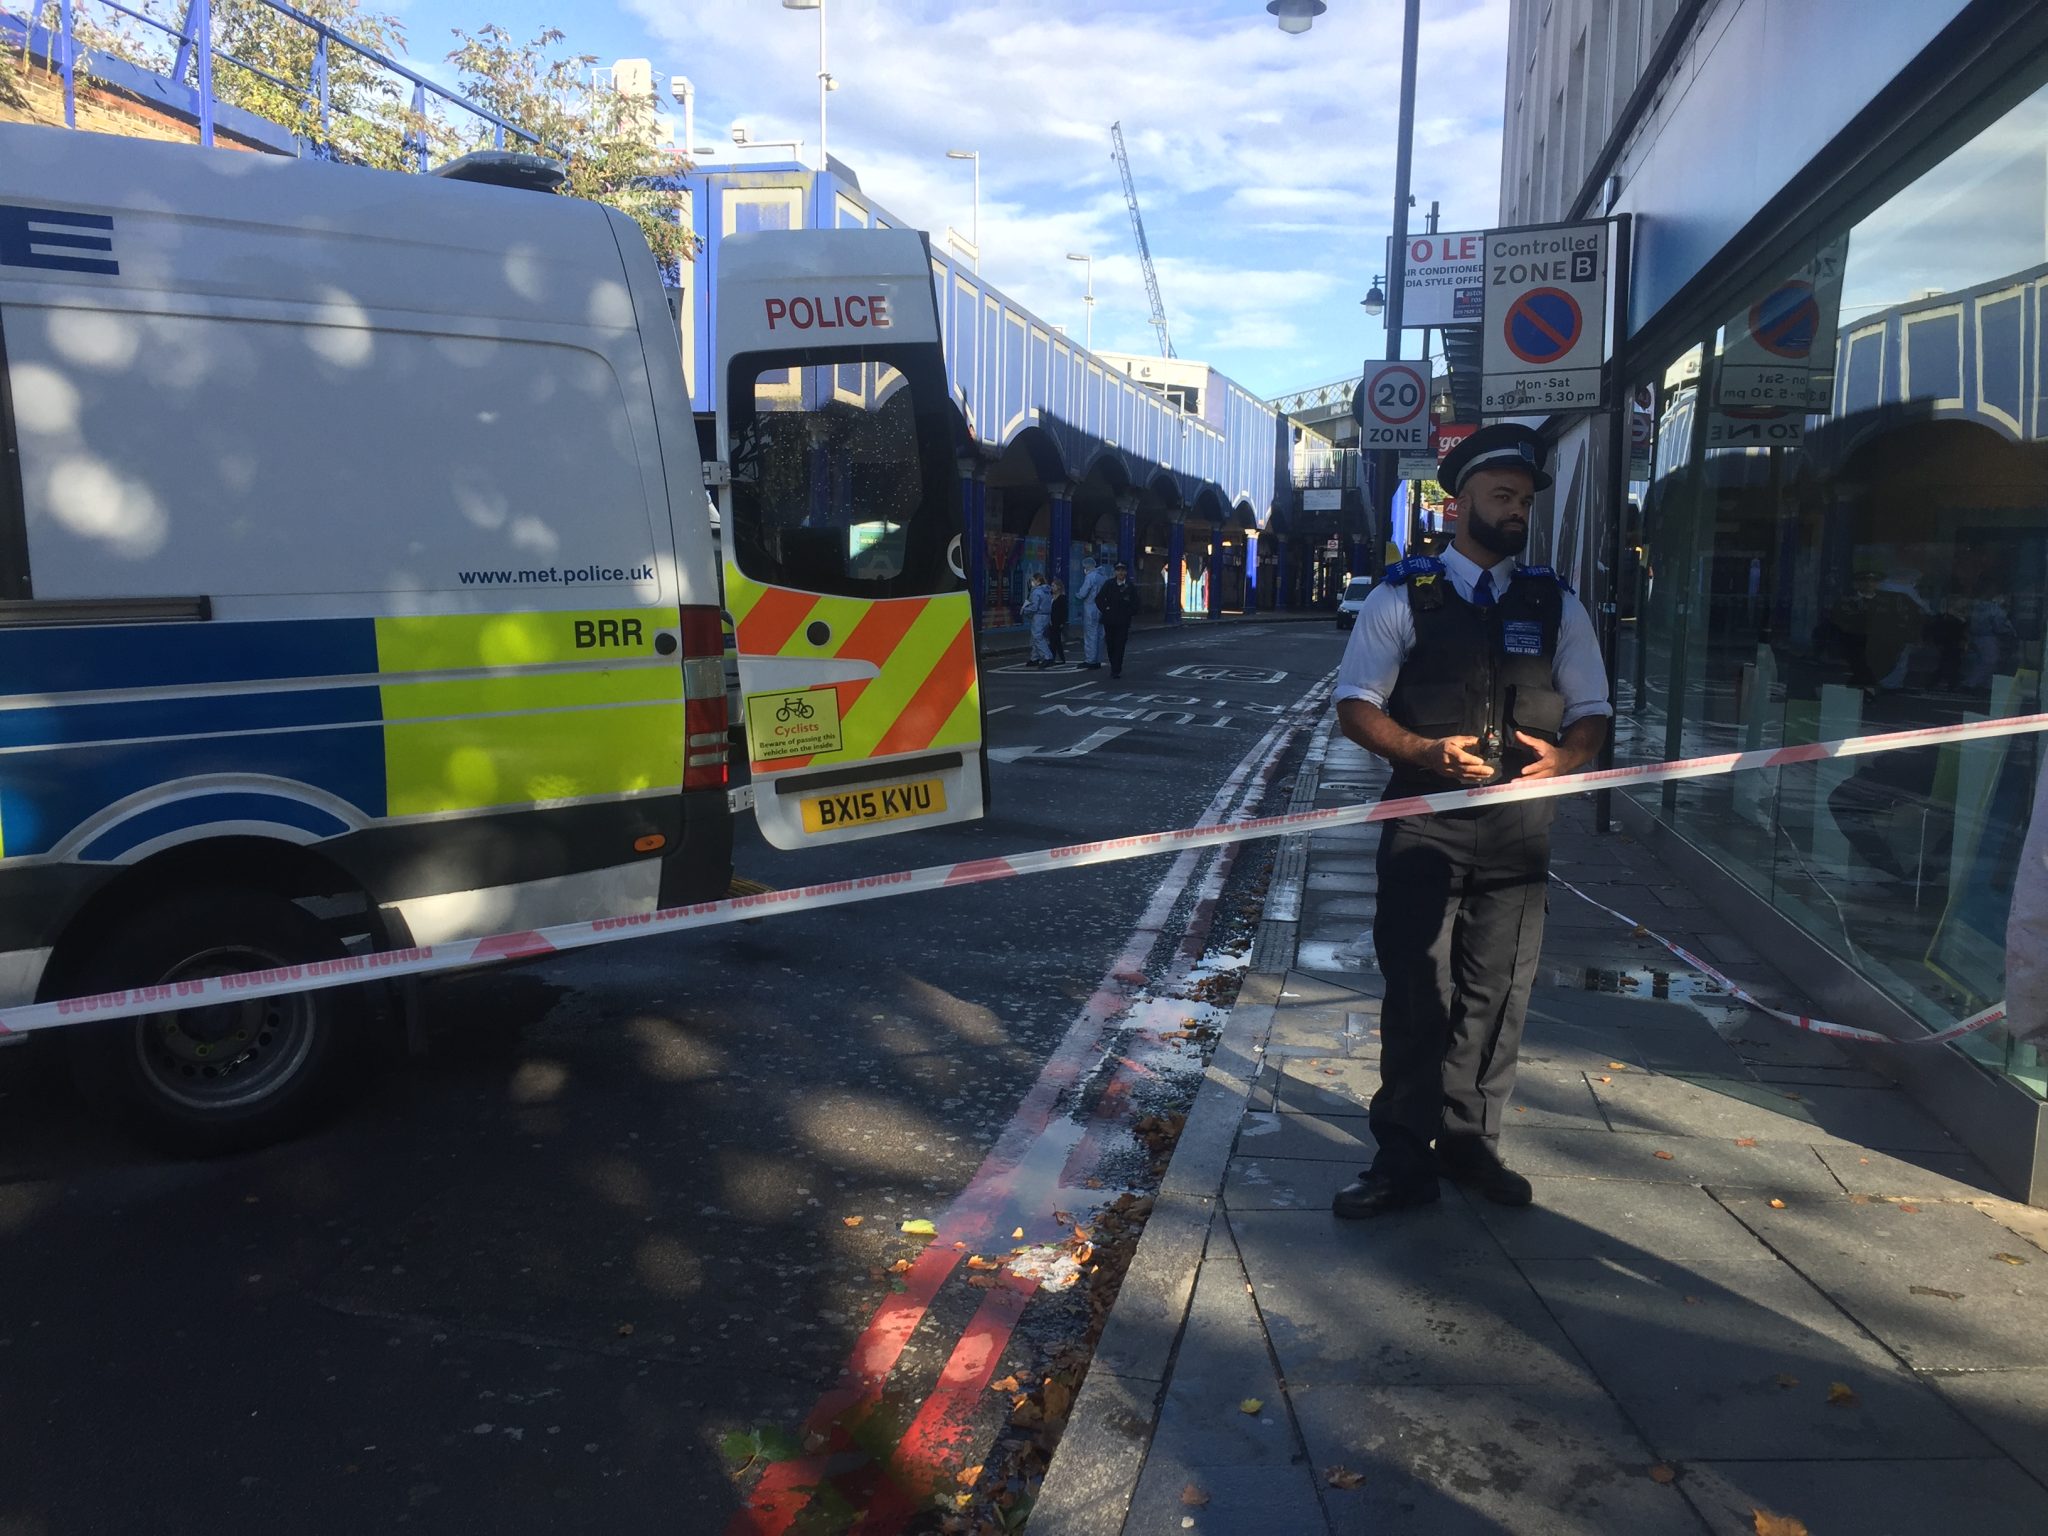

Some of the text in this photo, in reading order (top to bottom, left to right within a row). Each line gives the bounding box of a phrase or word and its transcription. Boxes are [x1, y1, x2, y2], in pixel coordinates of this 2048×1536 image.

[1406, 239, 1433, 263] O
[1493, 234, 1598, 258] Controlled
[1405, 275, 1484, 288] DIA STYLE OFFIC
[1492, 260, 1567, 286] ZONE
[765, 296, 890, 330] POLICE
[1378, 383, 1418, 407] 20
[1486, 394, 1515, 406] 8.30
[1518, 396, 1536, 405] am
[1545, 391, 1575, 403] 5.30
[1577, 391, 1596, 403] pm
[1369, 428, 1422, 443] ZONE
[1438, 435, 1468, 453] go
[458, 564, 654, 586] www.met.police.uk
[574, 618, 643, 649] BRR
[1033, 704, 1241, 730] TURN
[759, 740, 786, 749] Beware
[796, 735, 821, 745] passing
[774, 723, 820, 738] Cyclists
[763, 747, 788, 757] vehicle
[800, 744, 812, 752] the
[813, 741, 833, 750] inside
[818, 784, 931, 825] BX15 KVU
